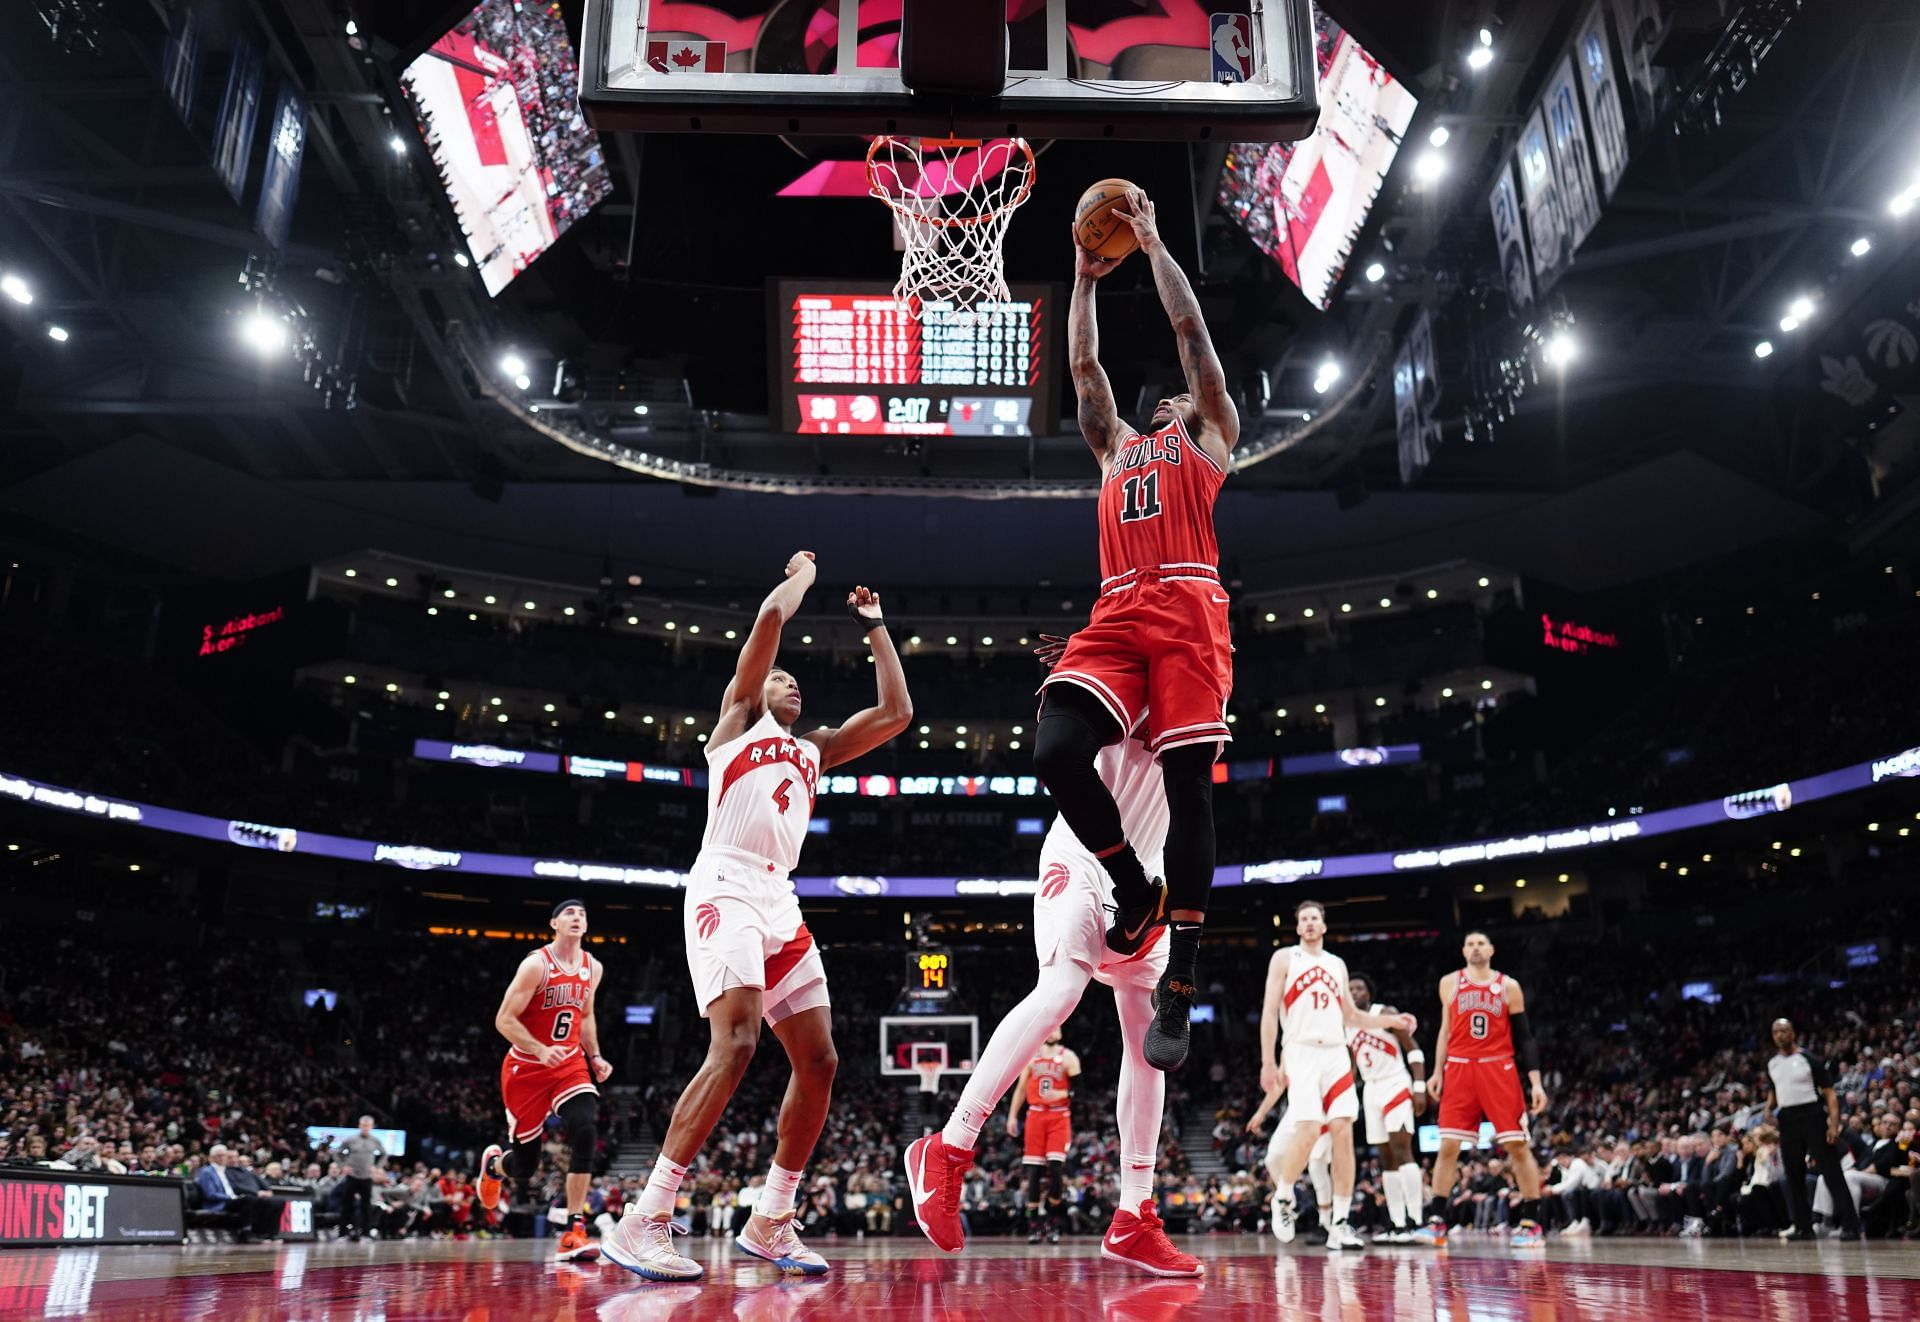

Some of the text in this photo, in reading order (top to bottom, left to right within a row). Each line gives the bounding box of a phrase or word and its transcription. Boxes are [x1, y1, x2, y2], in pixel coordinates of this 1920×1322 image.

[888, 397, 930, 423] 2:07
[1111, 435, 1181, 480] BULLS
[1120, 469, 1162, 524] 11
[772, 777, 793, 816] 4
[945, 811, 1004, 825] STREET
[924, 969, 943, 988] 14
[1311, 991, 1329, 1010] 19
[551, 1010, 574, 1041] 6
[1470, 1012, 1489, 1039] 9
